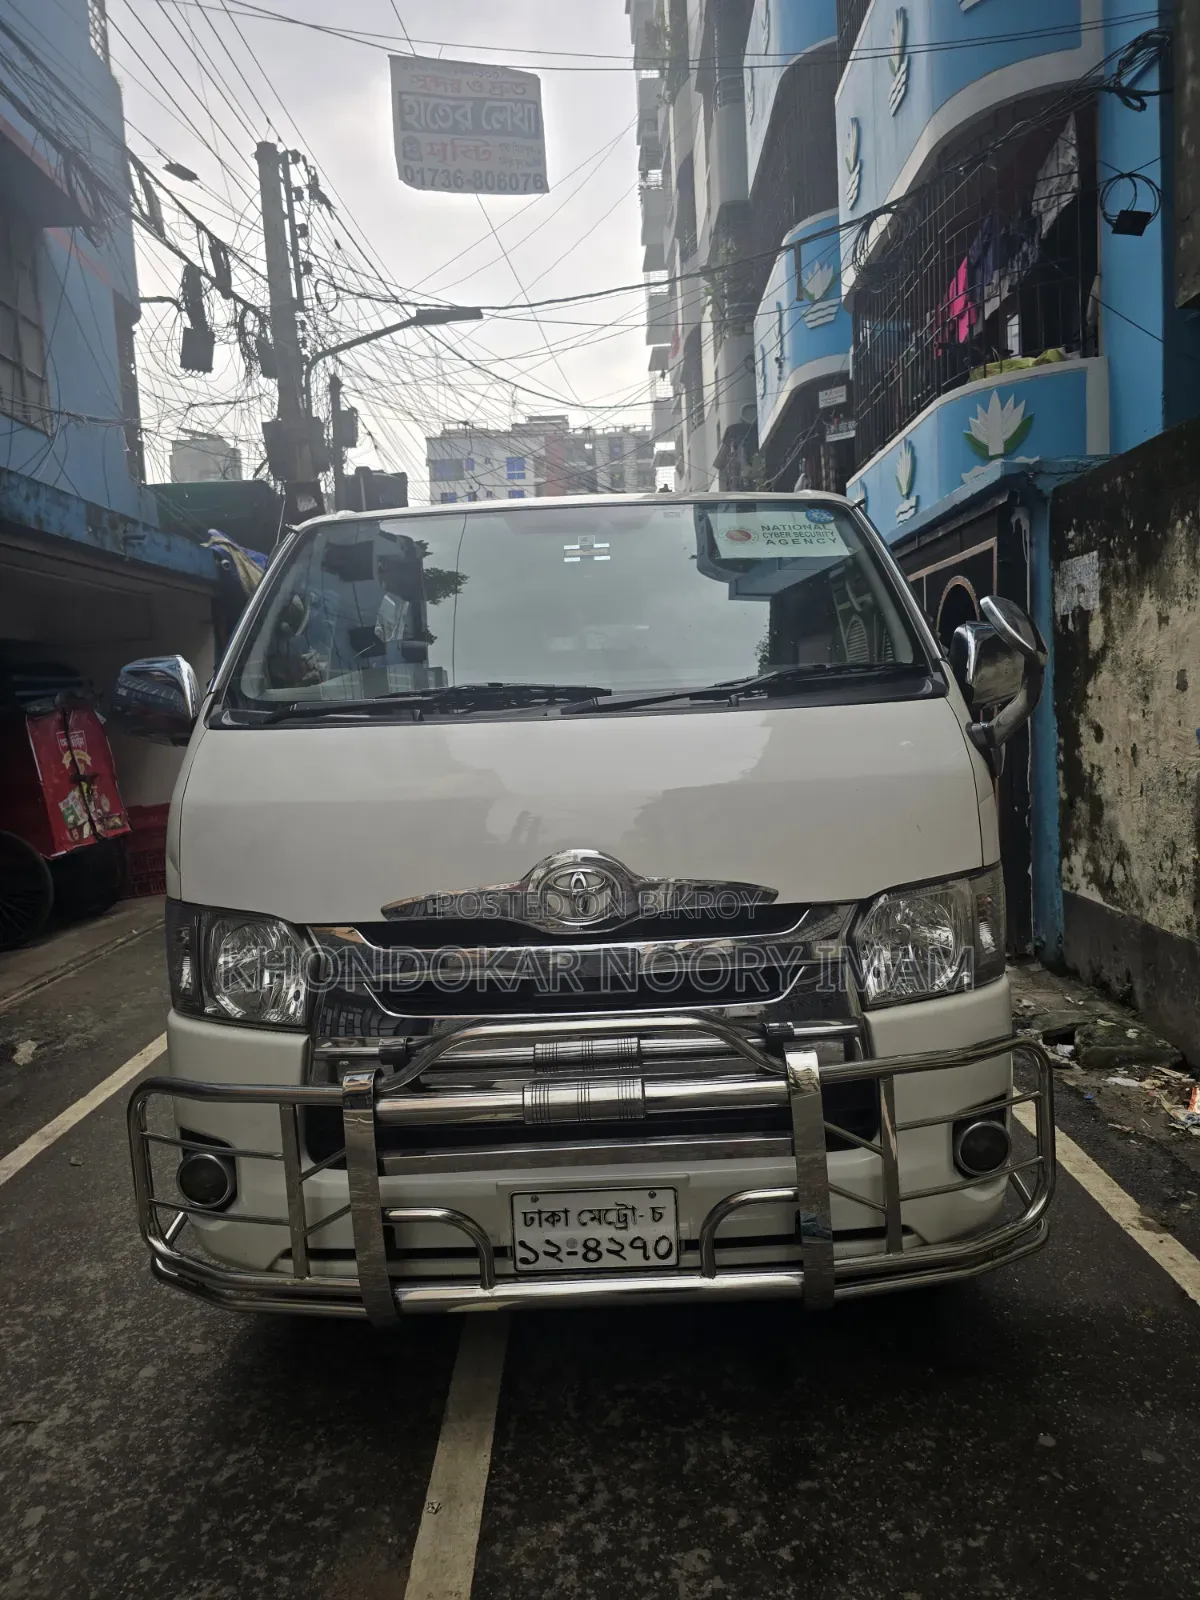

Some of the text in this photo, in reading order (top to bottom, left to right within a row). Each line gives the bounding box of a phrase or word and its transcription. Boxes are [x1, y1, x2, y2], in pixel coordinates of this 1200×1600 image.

[400, 95, 537, 134] হাতের লেখা
[403, 165, 544, 191] 01736-806076
[760, 524, 832, 532] NATIONAL
[762, 531, 791, 539] CYBER
[765, 537, 837, 546] AGENCY
[521, 1208, 570, 1228] ঢাকা
[518, 1235, 673, 1265] ১২-৪২৭০
